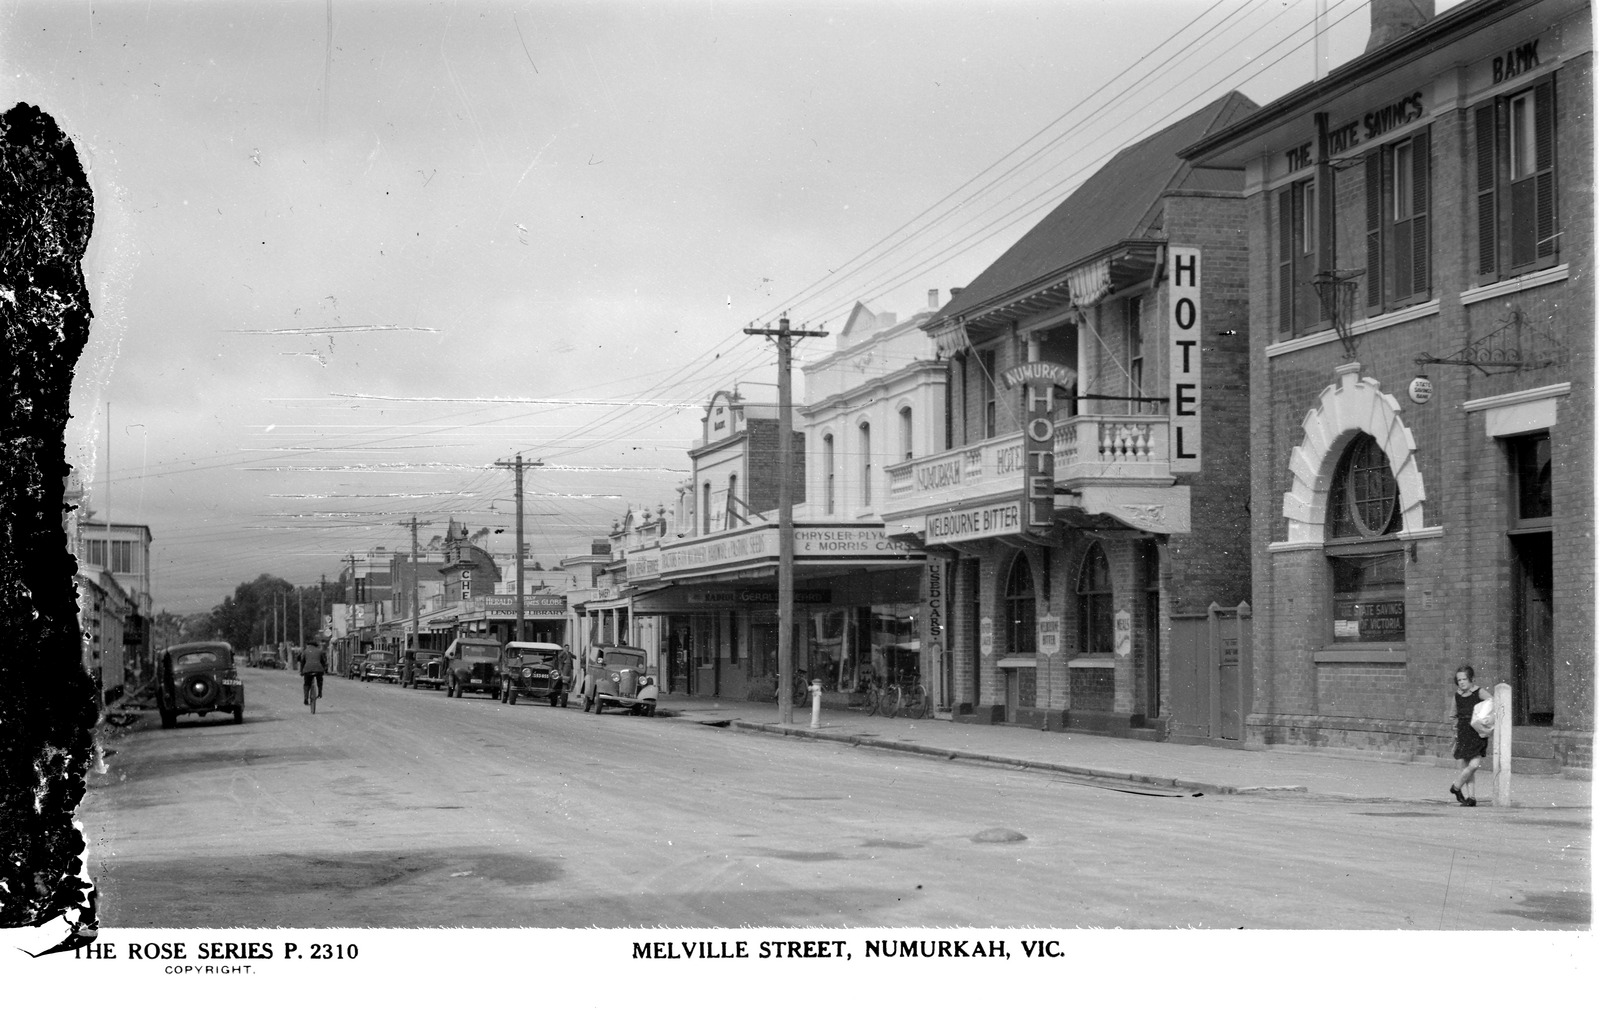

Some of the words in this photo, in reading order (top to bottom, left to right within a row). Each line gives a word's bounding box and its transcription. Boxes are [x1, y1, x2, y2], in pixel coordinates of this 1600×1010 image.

[1286, 141, 1313, 173] THE
[1328, 119, 1360, 155] TATE
[1363, 91, 1423, 140] SAVINGS
[1492, 38, 1541, 85] BANK
[1175, 254, 1197, 459] HOTEL
[916, 460, 960, 491] NUMURKAH
[996, 444, 1024, 475] HOTEL
[1028, 387, 1054, 527] HOTEL
[928, 511, 980, 538] MELBOURNE
[983, 505, 1018, 531] BITTER
[818, 541, 869, 551] MORRIS
[875, 541, 911, 551] CARS
[928, 564, 941, 598] USED
[486, 595, 513, 606] HERALD
[541, 598, 564, 606] GLOBE
[1354, 604, 1375, 617] STATE
[1376, 603, 1404, 616] SAVINGS
[930, 600, 942, 637] CARS
